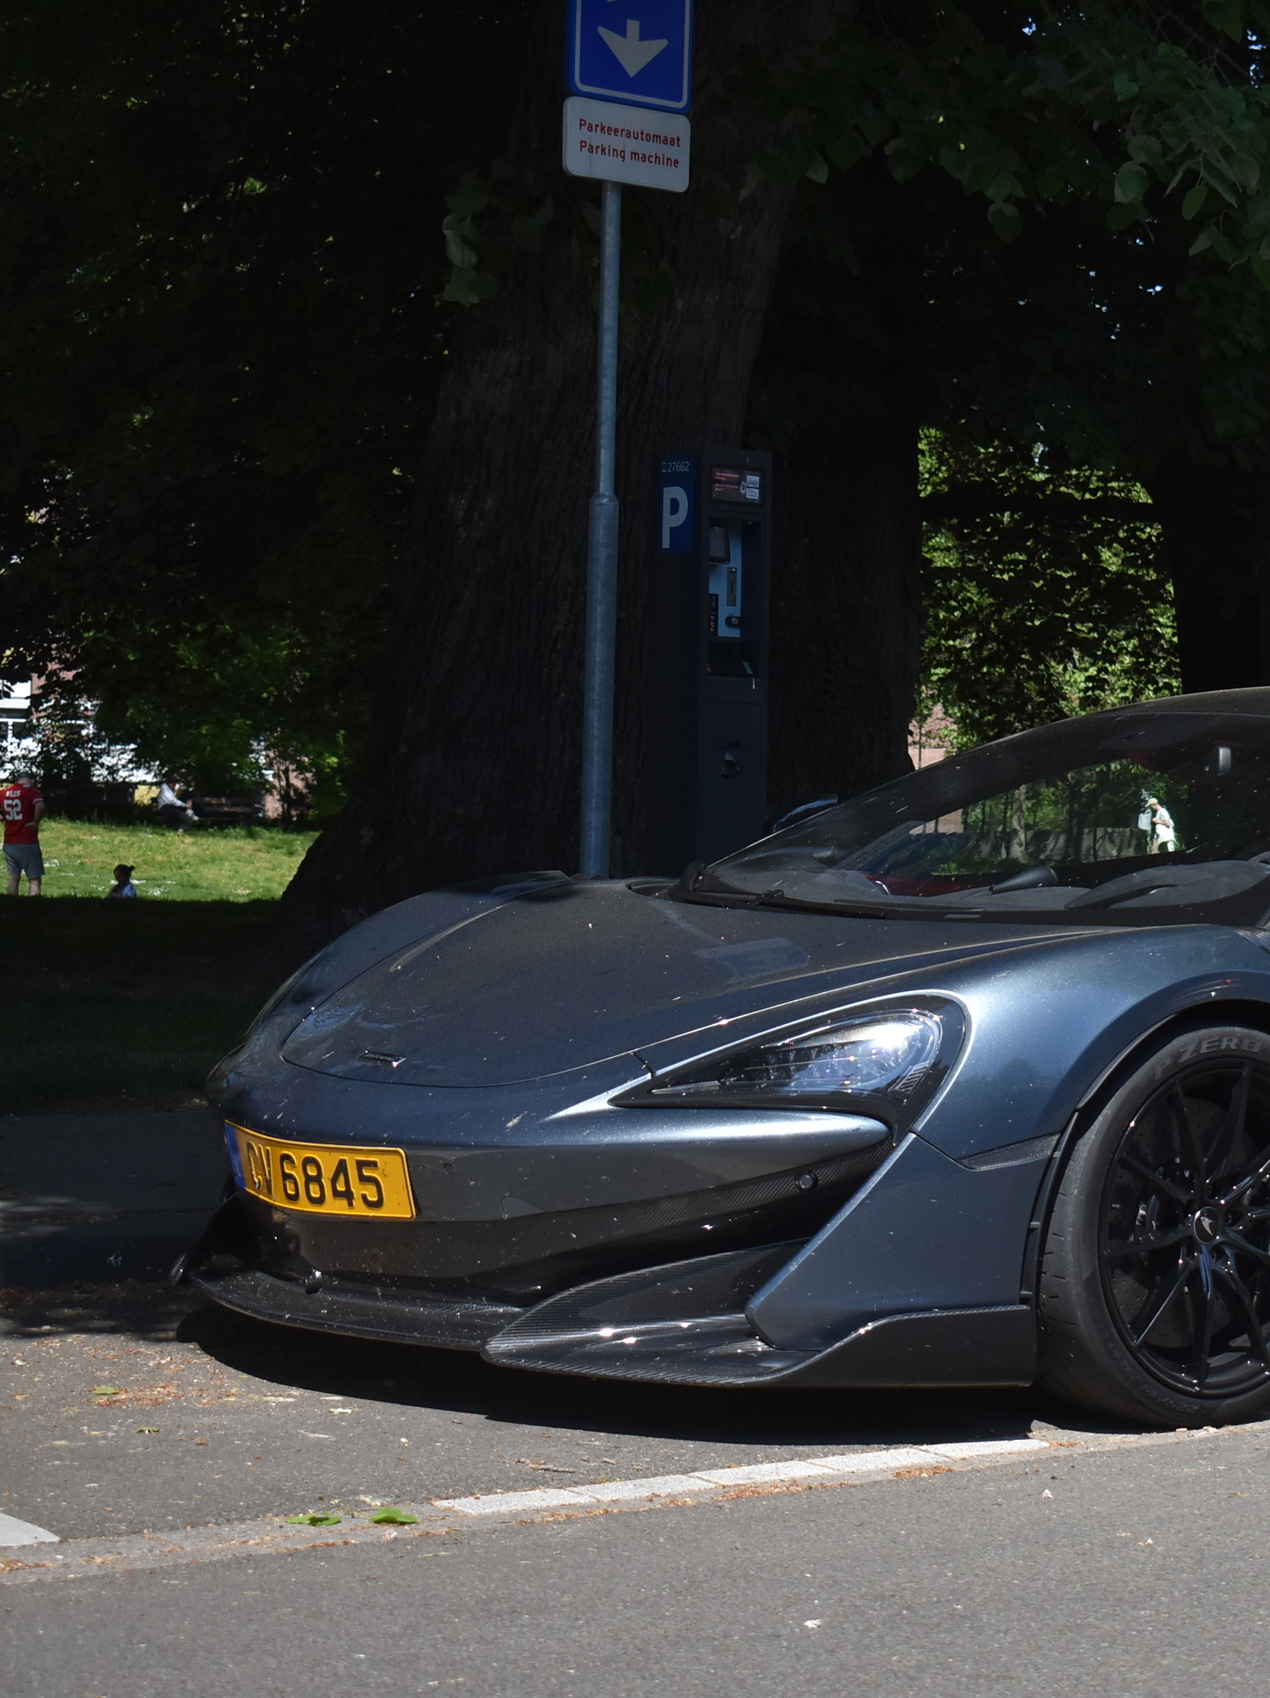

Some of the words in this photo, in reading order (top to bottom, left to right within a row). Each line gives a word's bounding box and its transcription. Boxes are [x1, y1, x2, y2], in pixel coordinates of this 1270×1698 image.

[579, 118, 681, 147] Parkeerautomaat
[580, 140, 625, 162] Parking
[631, 150, 679, 168] machine
[667, 461, 690, 473] 27662
[662, 486, 689, 549] P
[3, 799, 23, 820] 52
[1153, 1054, 1172, 1081] P
[1178, 1036, 1264, 1063] ZERO
[280, 1151, 386, 1210] 6845
